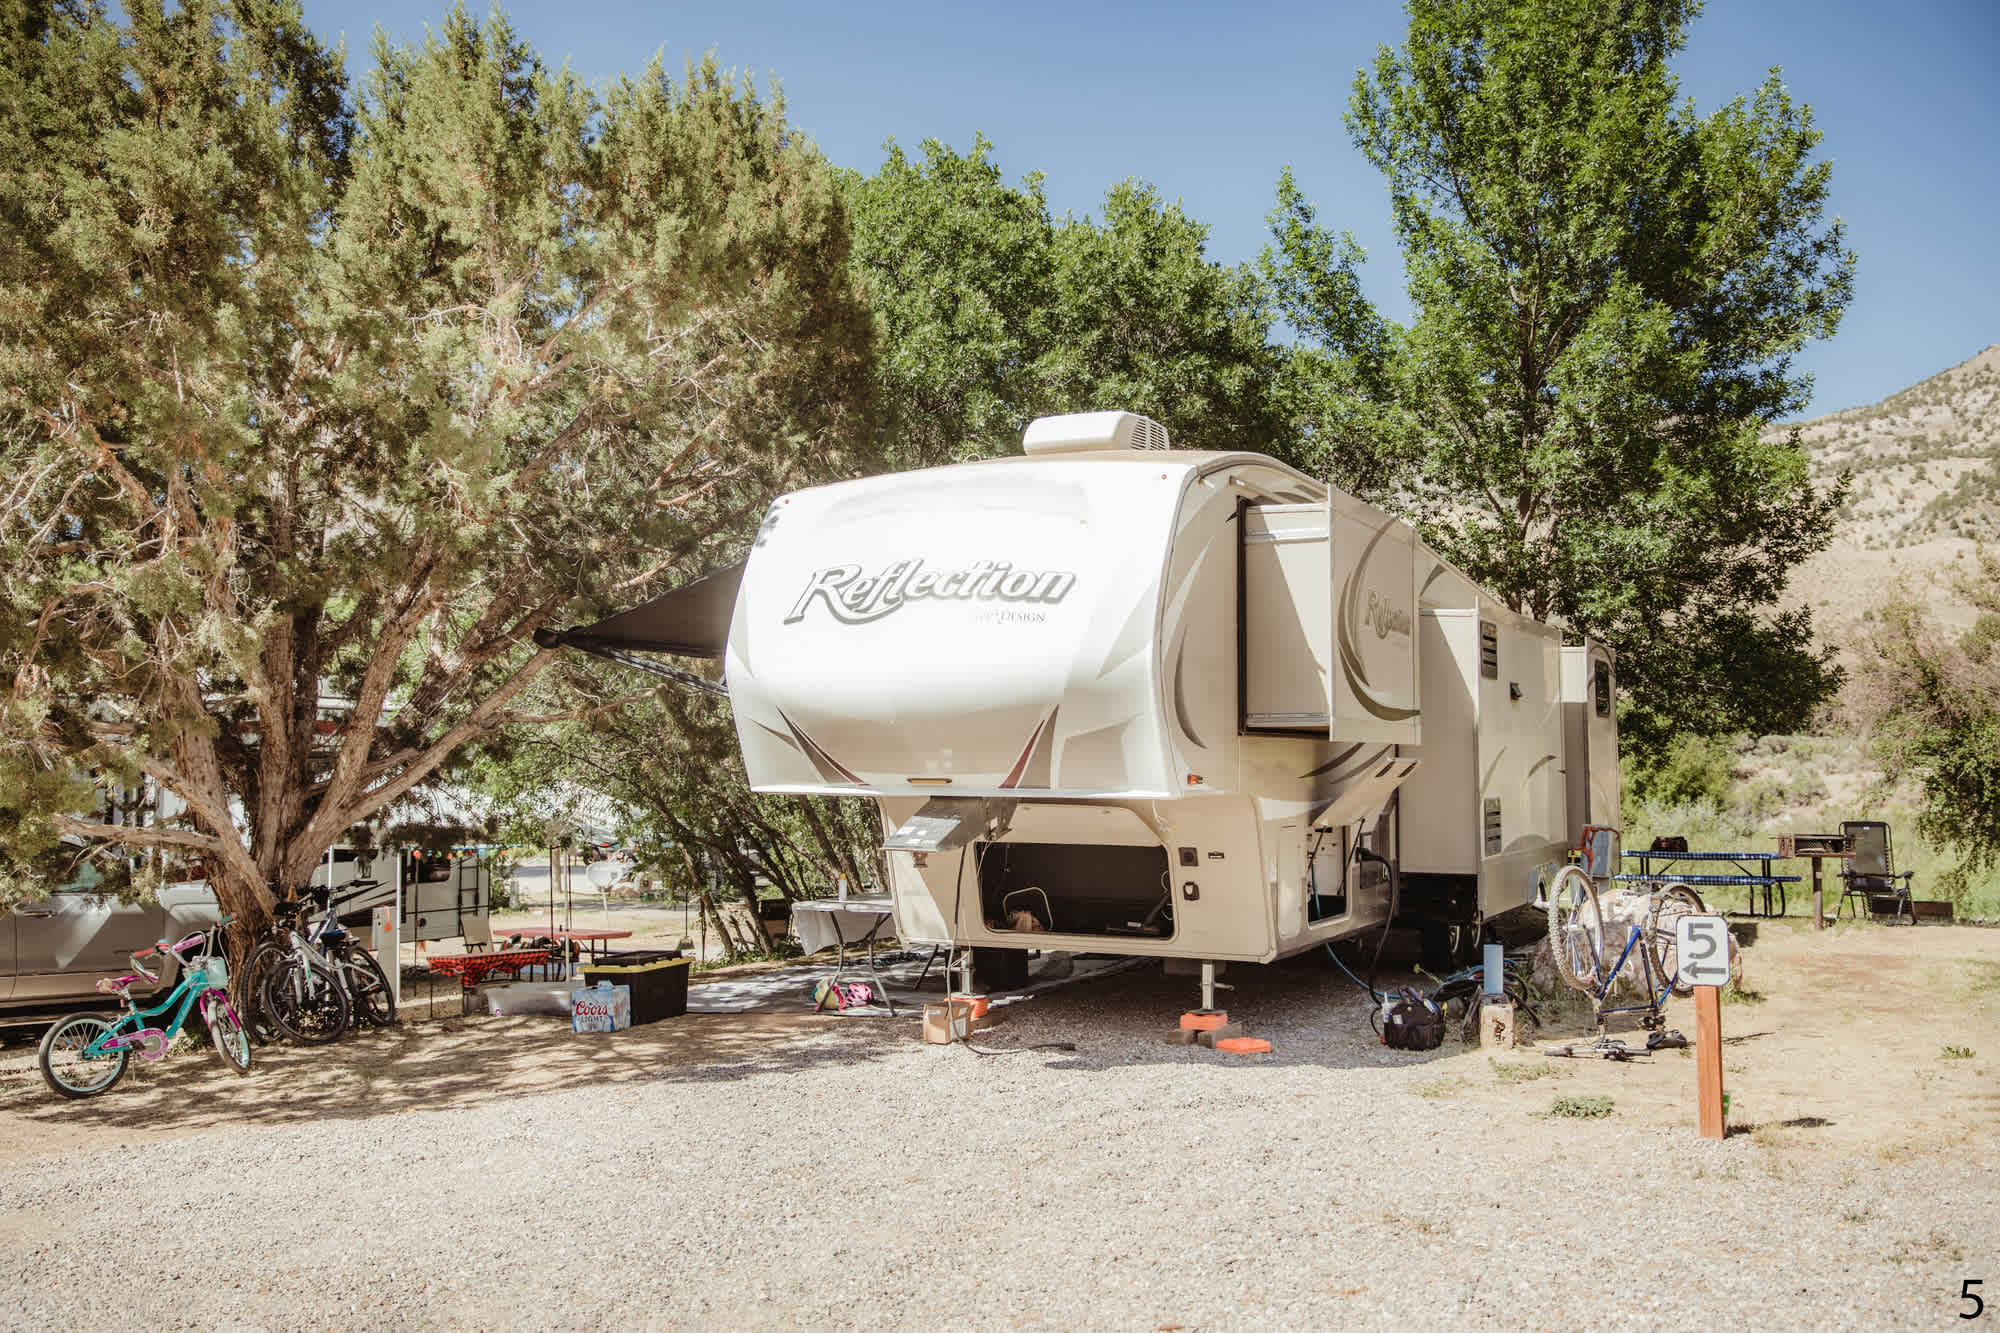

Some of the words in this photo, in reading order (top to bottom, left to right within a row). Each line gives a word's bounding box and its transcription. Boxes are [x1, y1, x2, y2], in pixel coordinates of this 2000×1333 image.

[783, 559, 1079, 626] Reflection
[1687, 922, 1717, 960] 5
[575, 1000, 608, 1016] Coors
